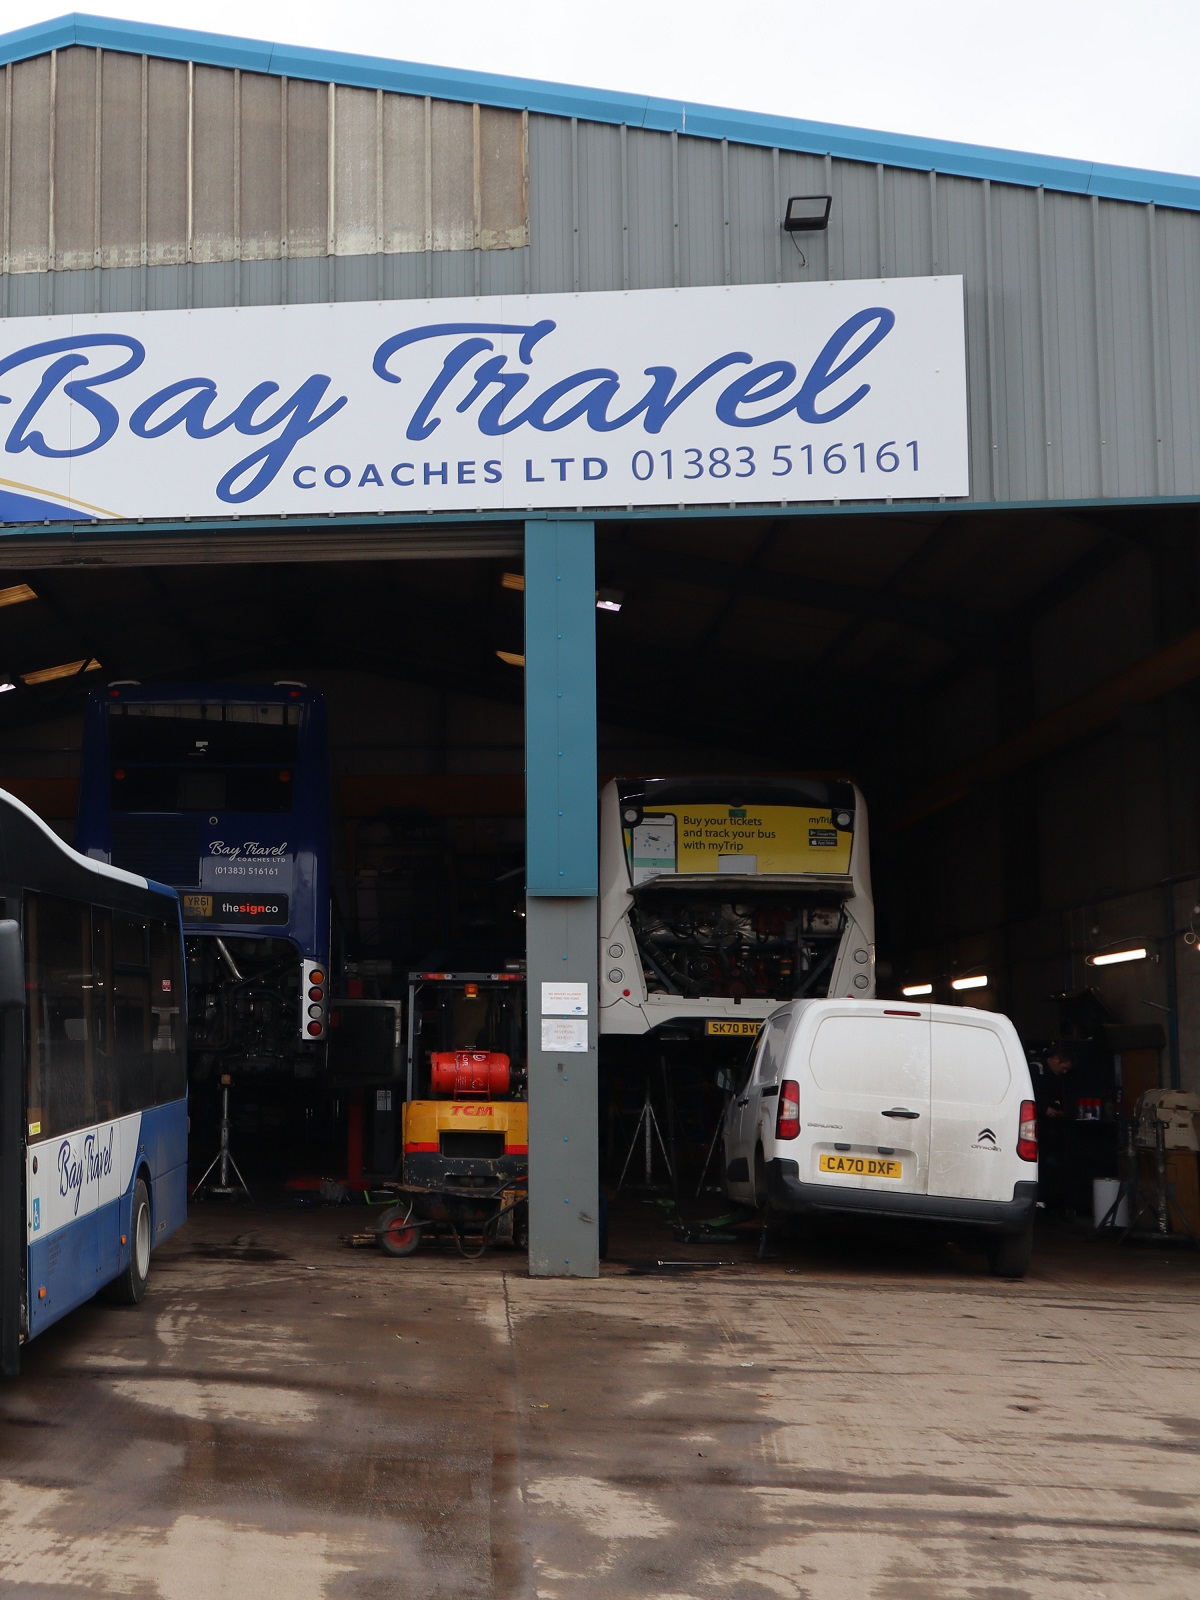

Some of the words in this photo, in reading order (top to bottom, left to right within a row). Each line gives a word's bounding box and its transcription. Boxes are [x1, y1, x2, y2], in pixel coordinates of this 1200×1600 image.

[373, 307, 896, 442] Travel
[292, 460, 503, 489] COACHES
[525, 457, 608, 482] LTD
[631, 446, 756, 480] 01383
[772, 440, 919, 475] 516161
[683, 816, 702, 826] Buy
[704, 818, 728, 827] your
[730, 817, 762, 826] tickets
[683, 829, 702, 838] and
[705, 829, 730, 838] track
[732, 830, 755, 840] your
[757, 829, 776, 839] bus
[209, 841, 241, 861] Bay
[243, 841, 287, 856] Travel
[683, 841, 706, 850] with
[708, 841, 744, 852] myTrip
[215, 866, 246, 875] (01383)
[248, 867, 278, 875] 516161
[187, 897, 210, 907] YR61
[222, 902, 279, 915] thesignco
[712, 1023, 740, 1033] SK70
[451, 1105, 495, 1117] TCM
[58, 1140, 83, 1216] Bay
[84, 1126, 114, 1184] Travel
[827, 1157, 864, 1172] CA70
[868, 1160, 896, 1175] DXF
